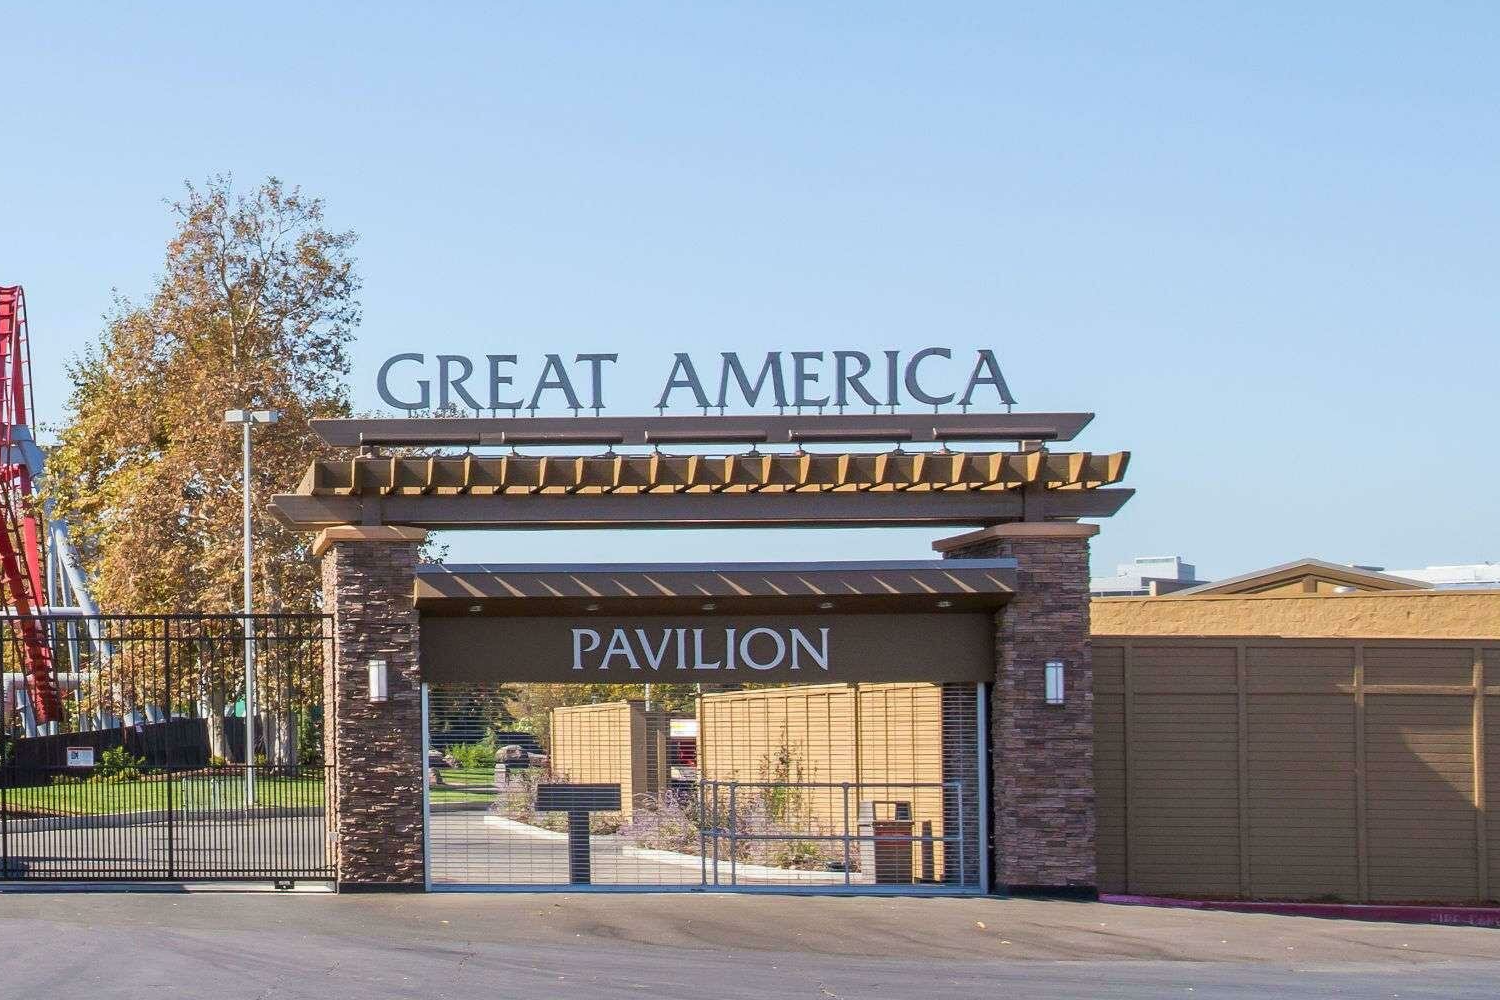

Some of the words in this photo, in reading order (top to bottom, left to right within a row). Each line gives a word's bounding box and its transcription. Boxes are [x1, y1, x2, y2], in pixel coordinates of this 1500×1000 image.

[376, 352, 619, 410] GREAT
[657, 347, 1018, 408] AMERICA
[571, 627, 830, 671] PAVILION
